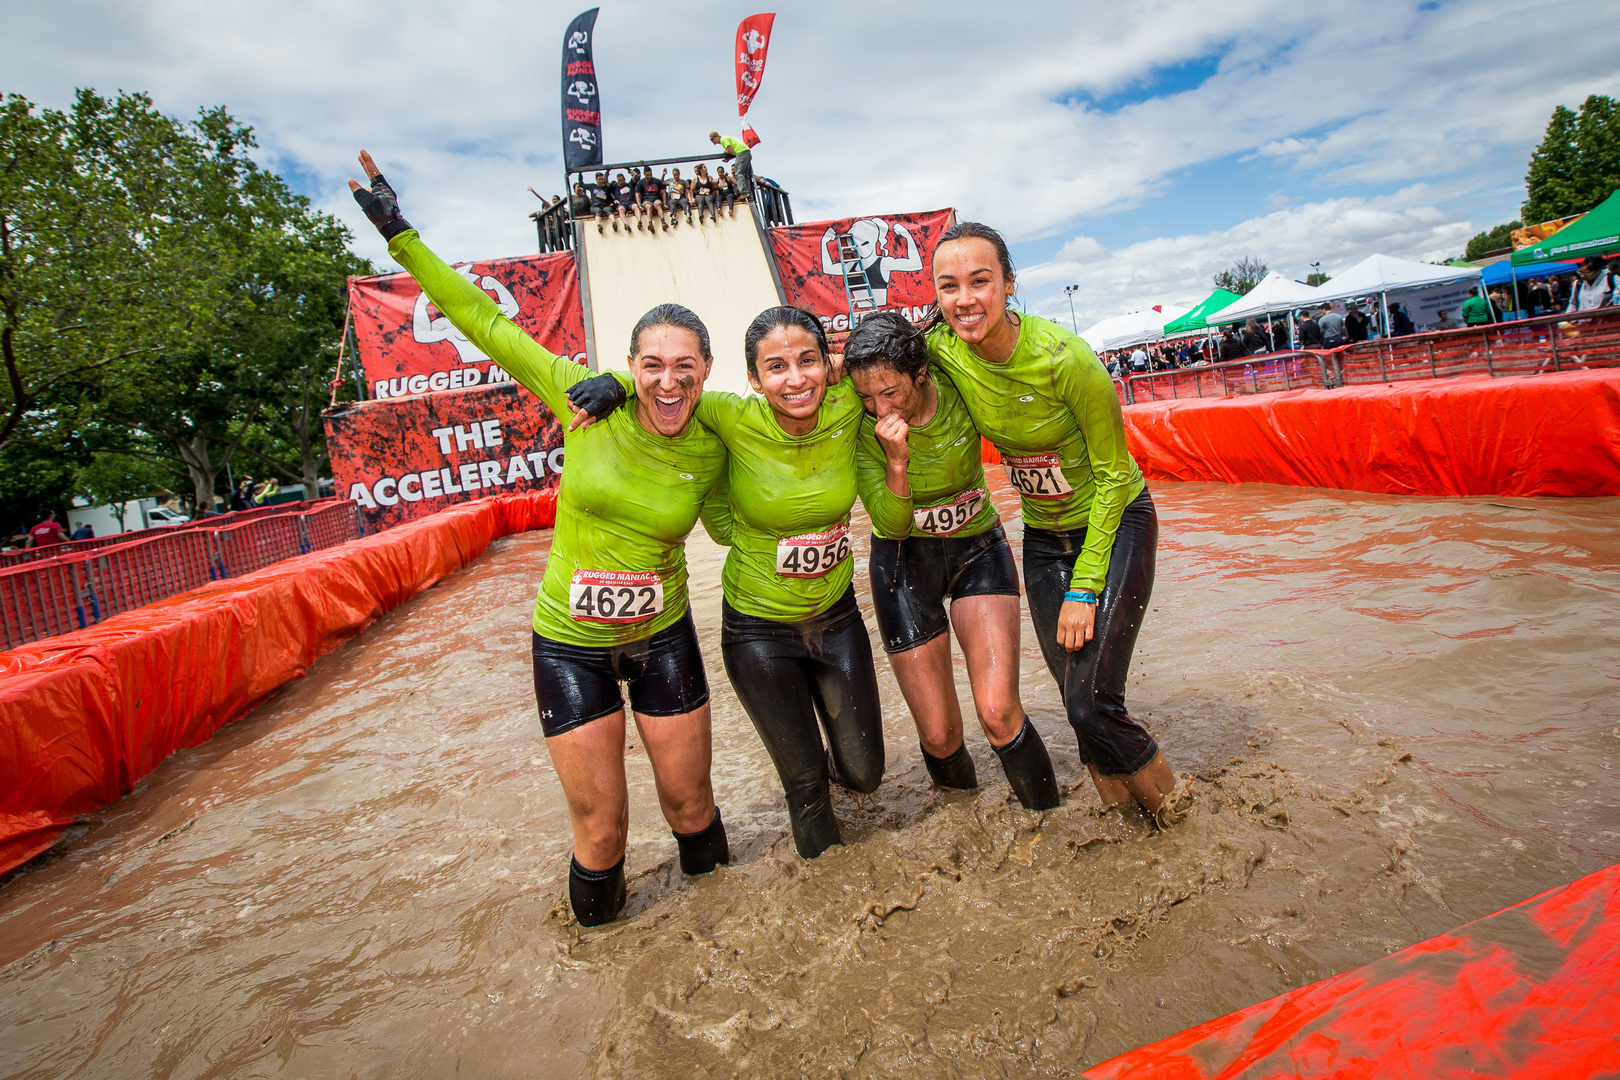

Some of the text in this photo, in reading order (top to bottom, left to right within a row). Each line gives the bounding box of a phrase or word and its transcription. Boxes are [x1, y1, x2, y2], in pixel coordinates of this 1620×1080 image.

[375, 368, 481, 399] RUGGED
[432, 419, 503, 455] THE
[1022, 455, 1049, 464] MANIAC
[349, 447, 565, 509] ACCELERATO
[1011, 467, 1062, 494] 4621
[922, 496, 981, 533] 4957
[782, 536, 849, 573] 4956
[583, 571, 650, 581] RUGGED MANIAC
[575, 586, 656, 617] 4622
